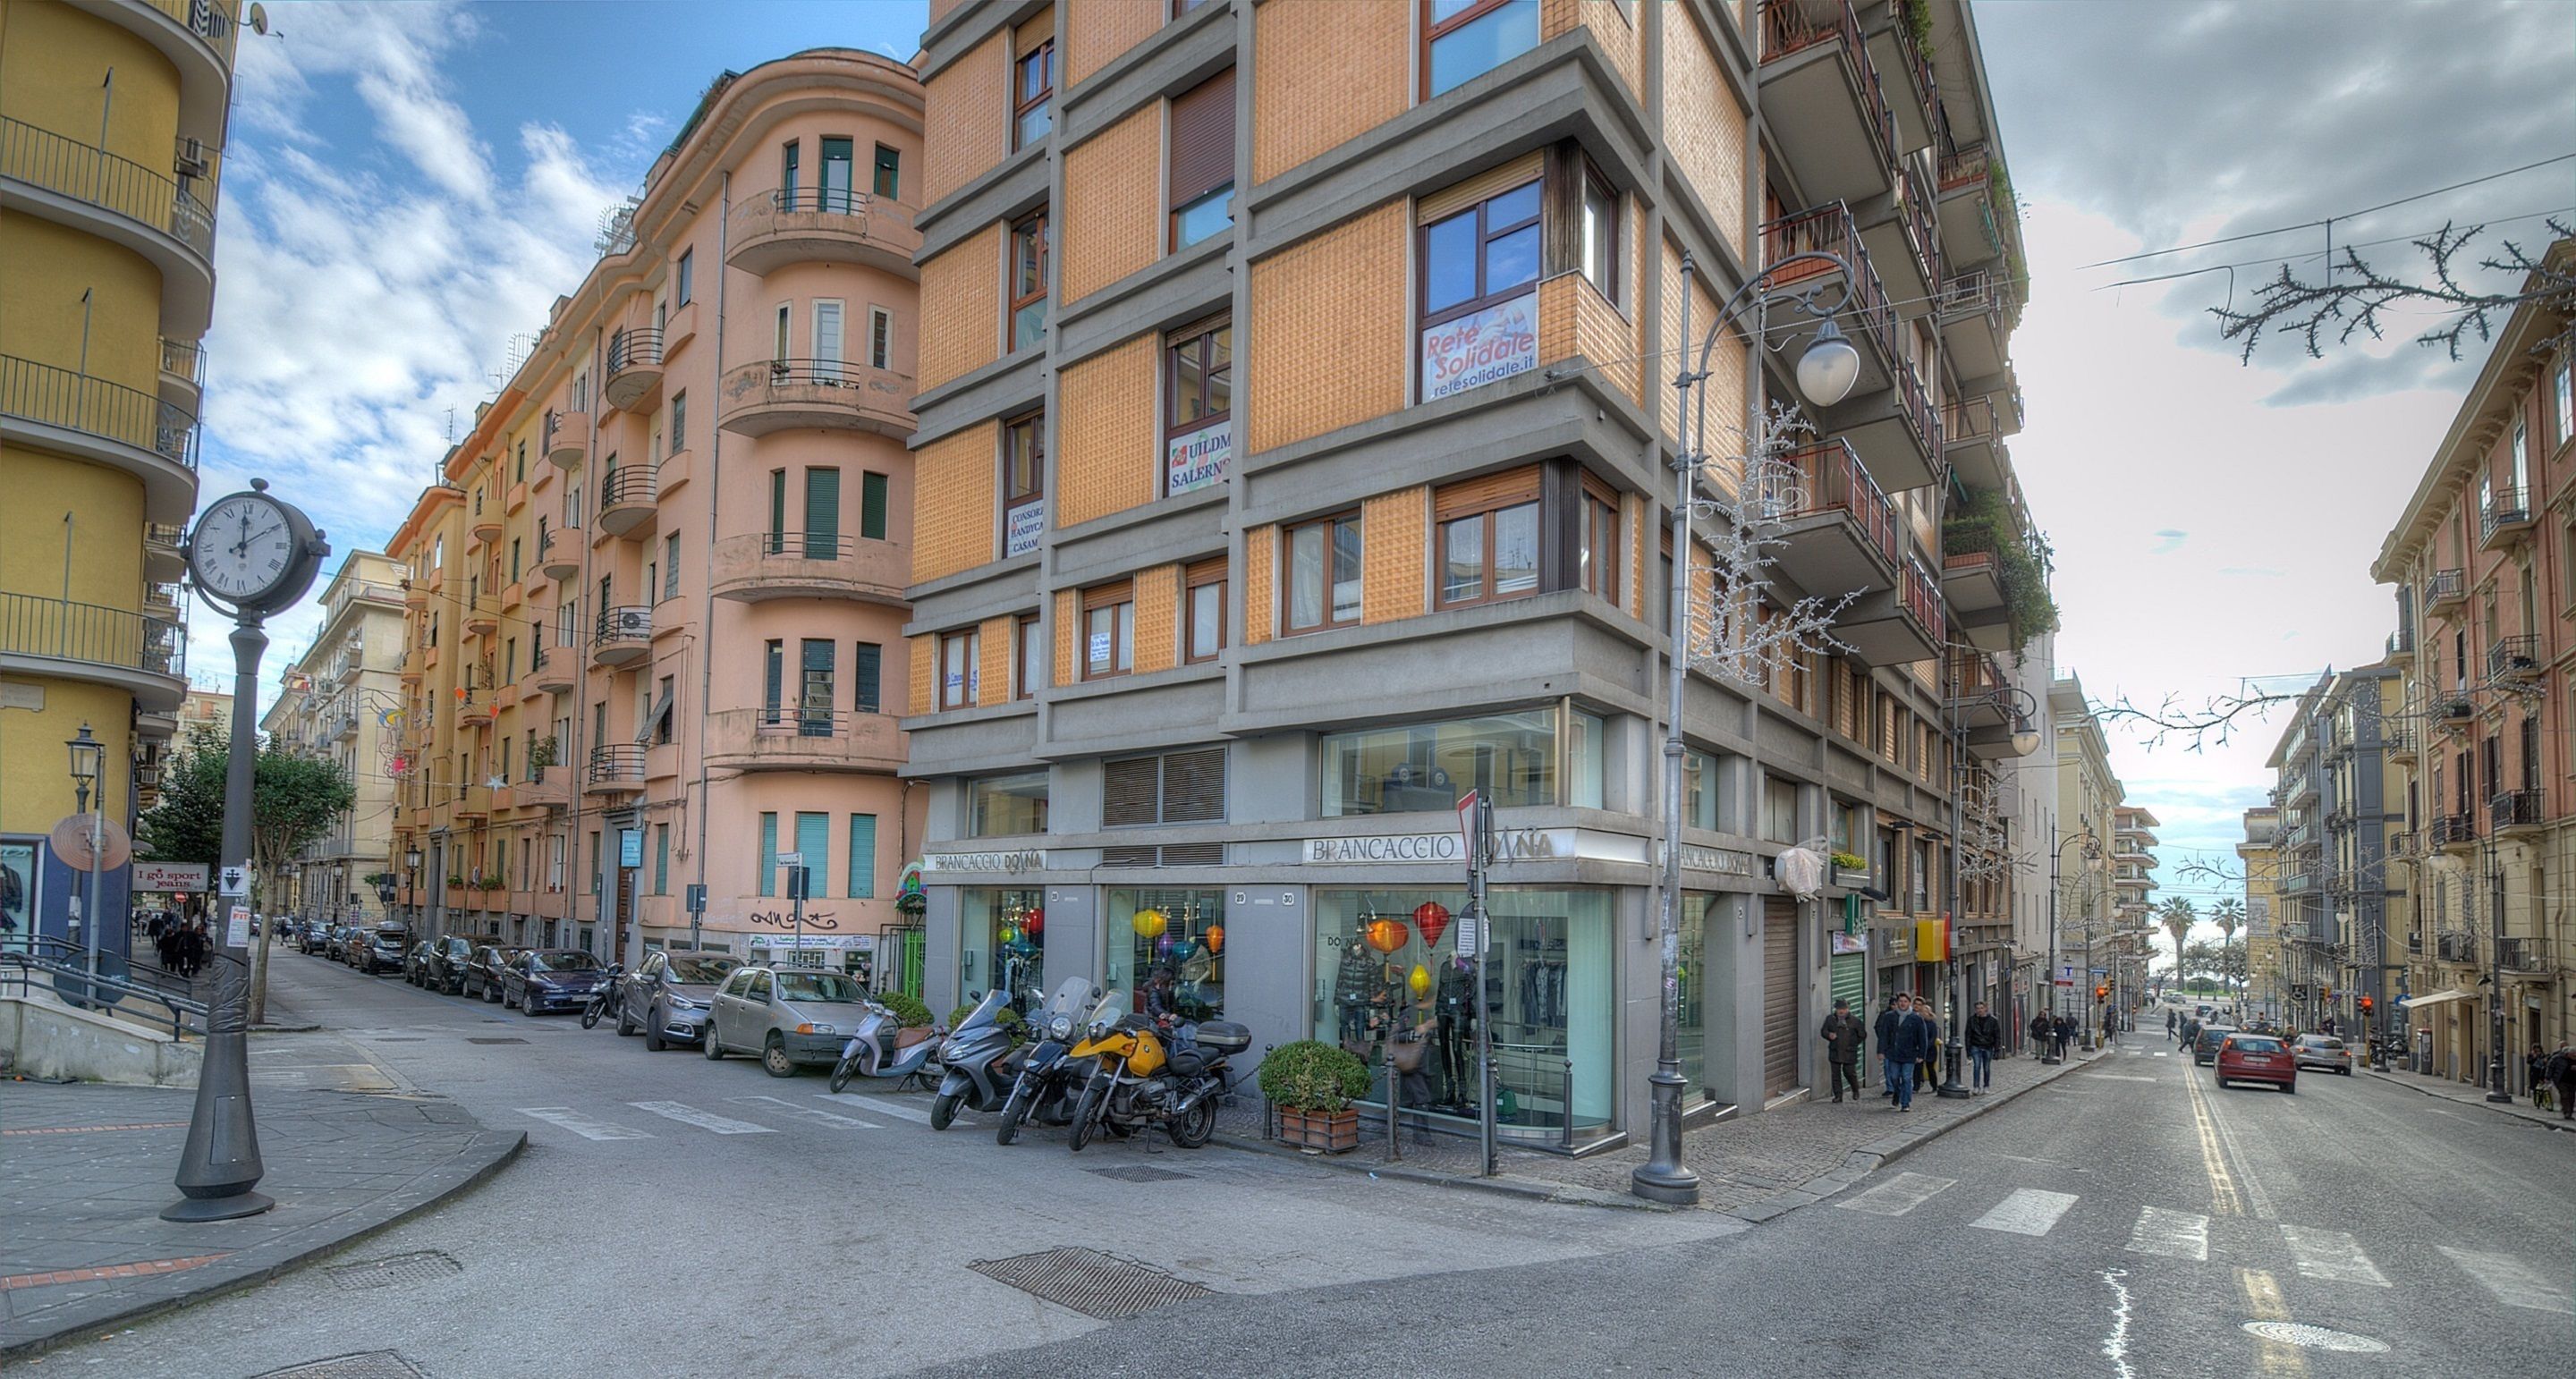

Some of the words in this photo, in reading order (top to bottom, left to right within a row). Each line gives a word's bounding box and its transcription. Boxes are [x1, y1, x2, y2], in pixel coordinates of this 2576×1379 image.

[1428, 324, 1481, 359] Rete
[1436, 332, 1534, 380] Solidale
[1435, 355, 1533, 397] retesolidale.it
[1190, 433, 1231, 459] UILDM
[1312, 835, 1454, 861] BRANCACCIO
[936, 854, 1001, 869] BRANCACCIO
[155, 880, 191, 889] jeans
[167, 872, 201, 882] sport
[1284, 894, 1293, 903] 30
[2064, 967, 2073, 976] T
